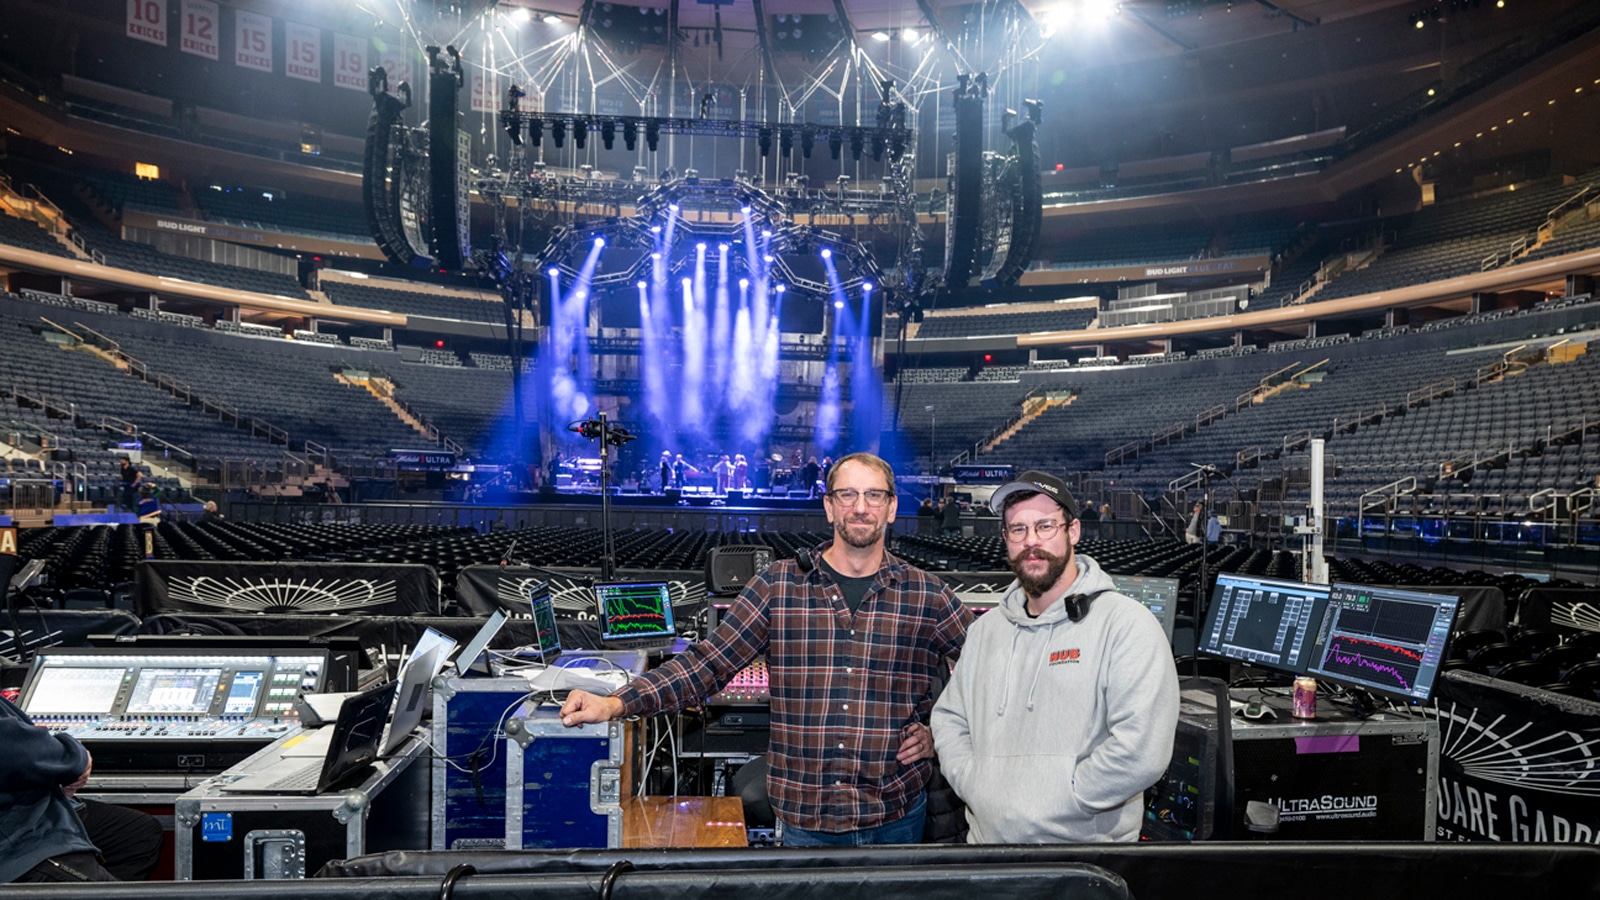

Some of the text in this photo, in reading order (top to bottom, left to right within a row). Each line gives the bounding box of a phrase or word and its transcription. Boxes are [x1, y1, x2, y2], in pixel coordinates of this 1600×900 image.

[133, 0, 160, 25] 10
[129, 22, 165, 42] KNICKS
[187, 13, 212, 40] 12
[183, 37, 217, 56] KNICKS
[242, 28, 266, 53] 15
[238, 53, 270, 68] KNICKS
[292, 40, 315, 63] 15
[288, 64, 319, 78] KNICKS
[339, 51, 362, 73] 19
[335, 73, 366, 88] KNICKS
[157, 220, 178, 230] BUD
[179, 223, 207, 234] LIGHT
[1146, 268, 1164, 276] BUD
[1164, 266, 1188, 275] LIGHT
[425, 456, 451, 464] ULTRA
[1, 530, 16, 552] A
[1049, 649, 1080, 662] HUB
